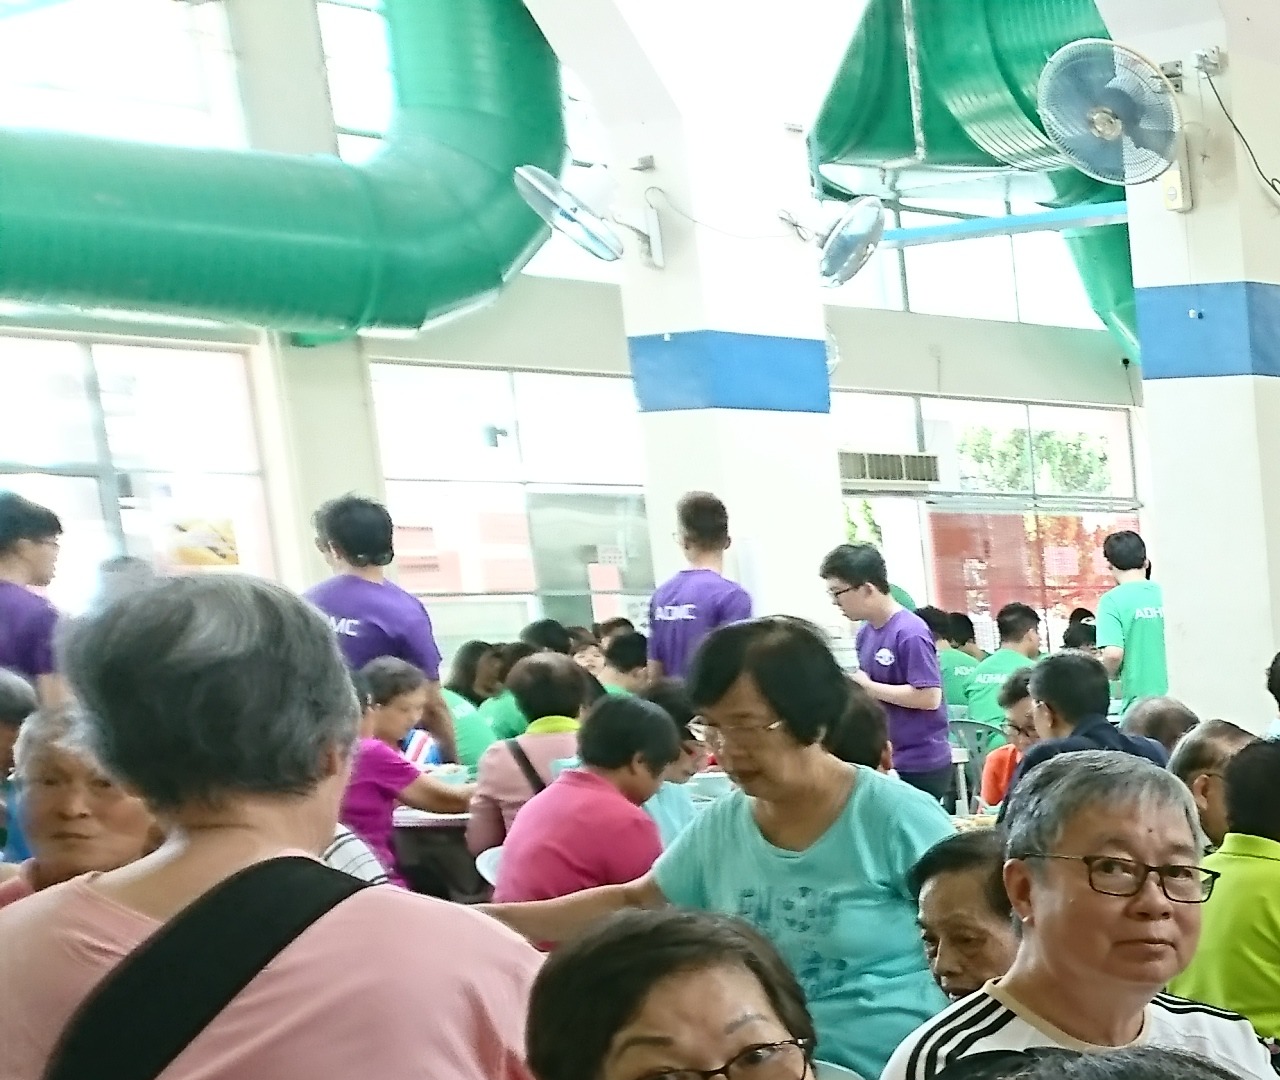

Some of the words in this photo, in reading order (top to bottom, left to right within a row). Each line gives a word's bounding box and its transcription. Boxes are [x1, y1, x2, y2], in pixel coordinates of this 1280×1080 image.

[654, 603, 697, 621] ADMC
[1134, 606, 1164, 620] ADH
[329, 616, 361, 637] MC
